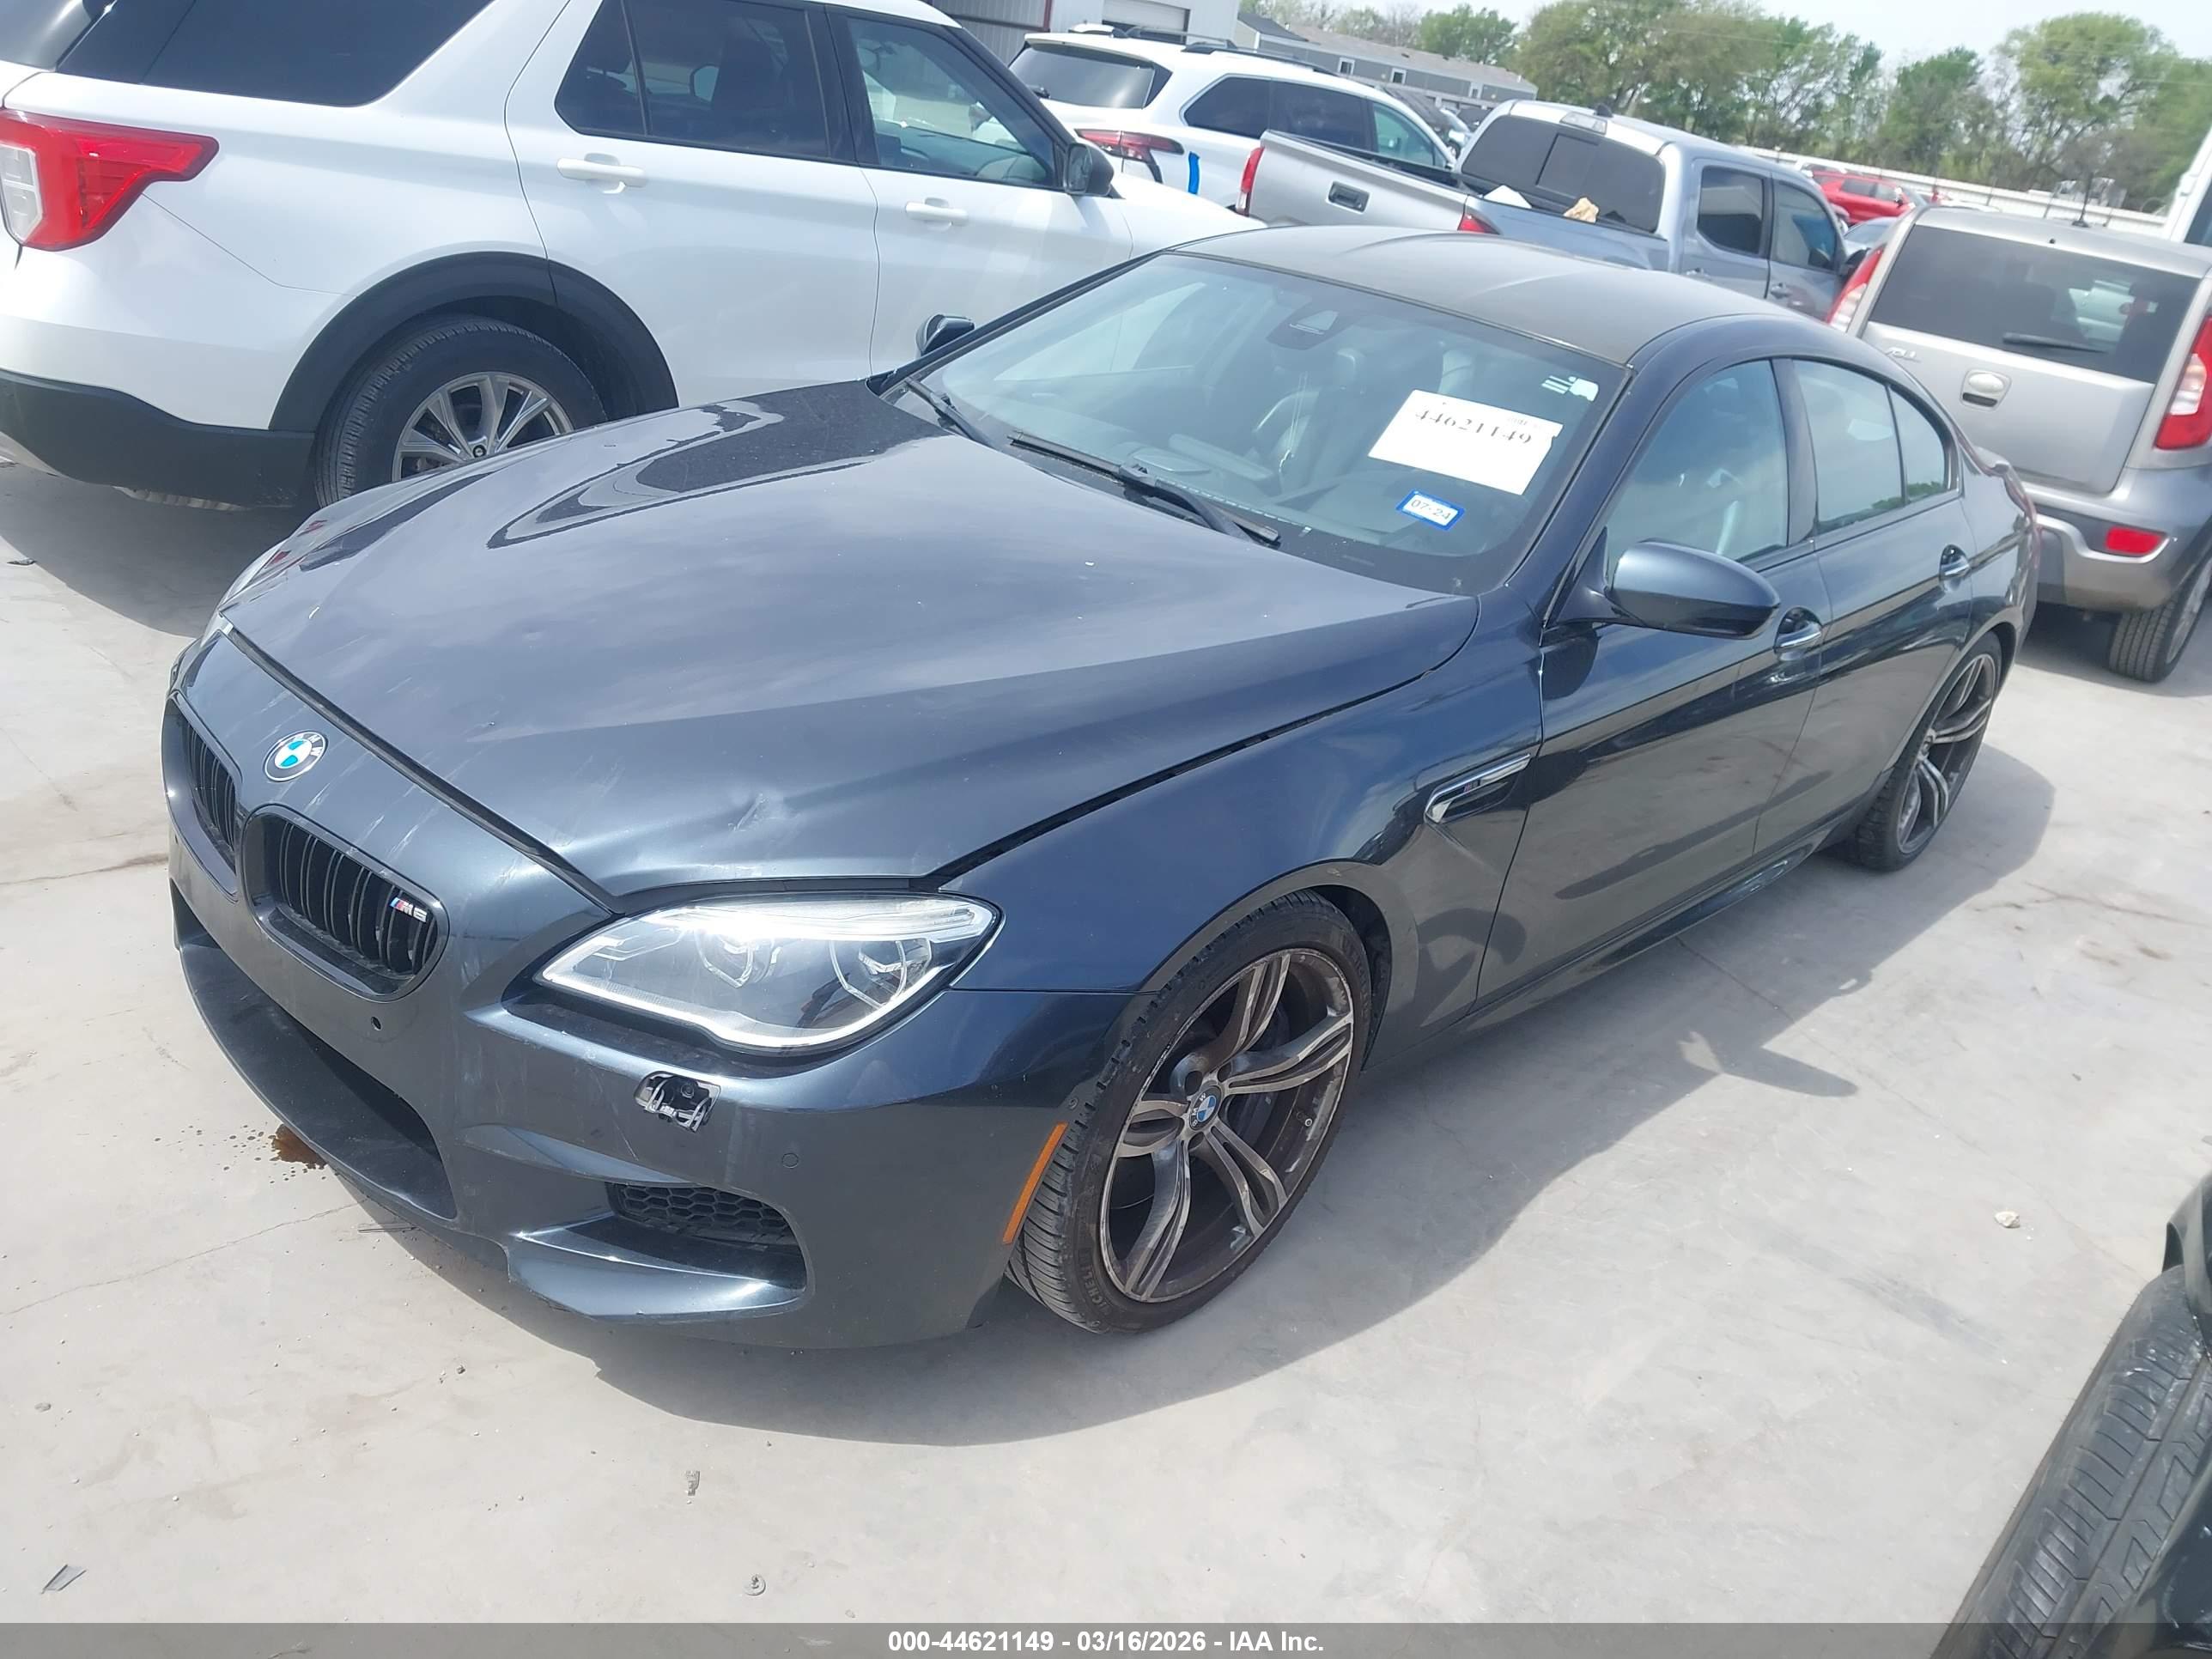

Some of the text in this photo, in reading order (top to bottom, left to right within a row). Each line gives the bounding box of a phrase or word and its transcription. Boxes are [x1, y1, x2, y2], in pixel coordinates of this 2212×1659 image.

[1415, 409, 1533, 444] 44621149
[392, 897, 428, 923] M6
[1191, 1092, 1206, 1127] BMW
